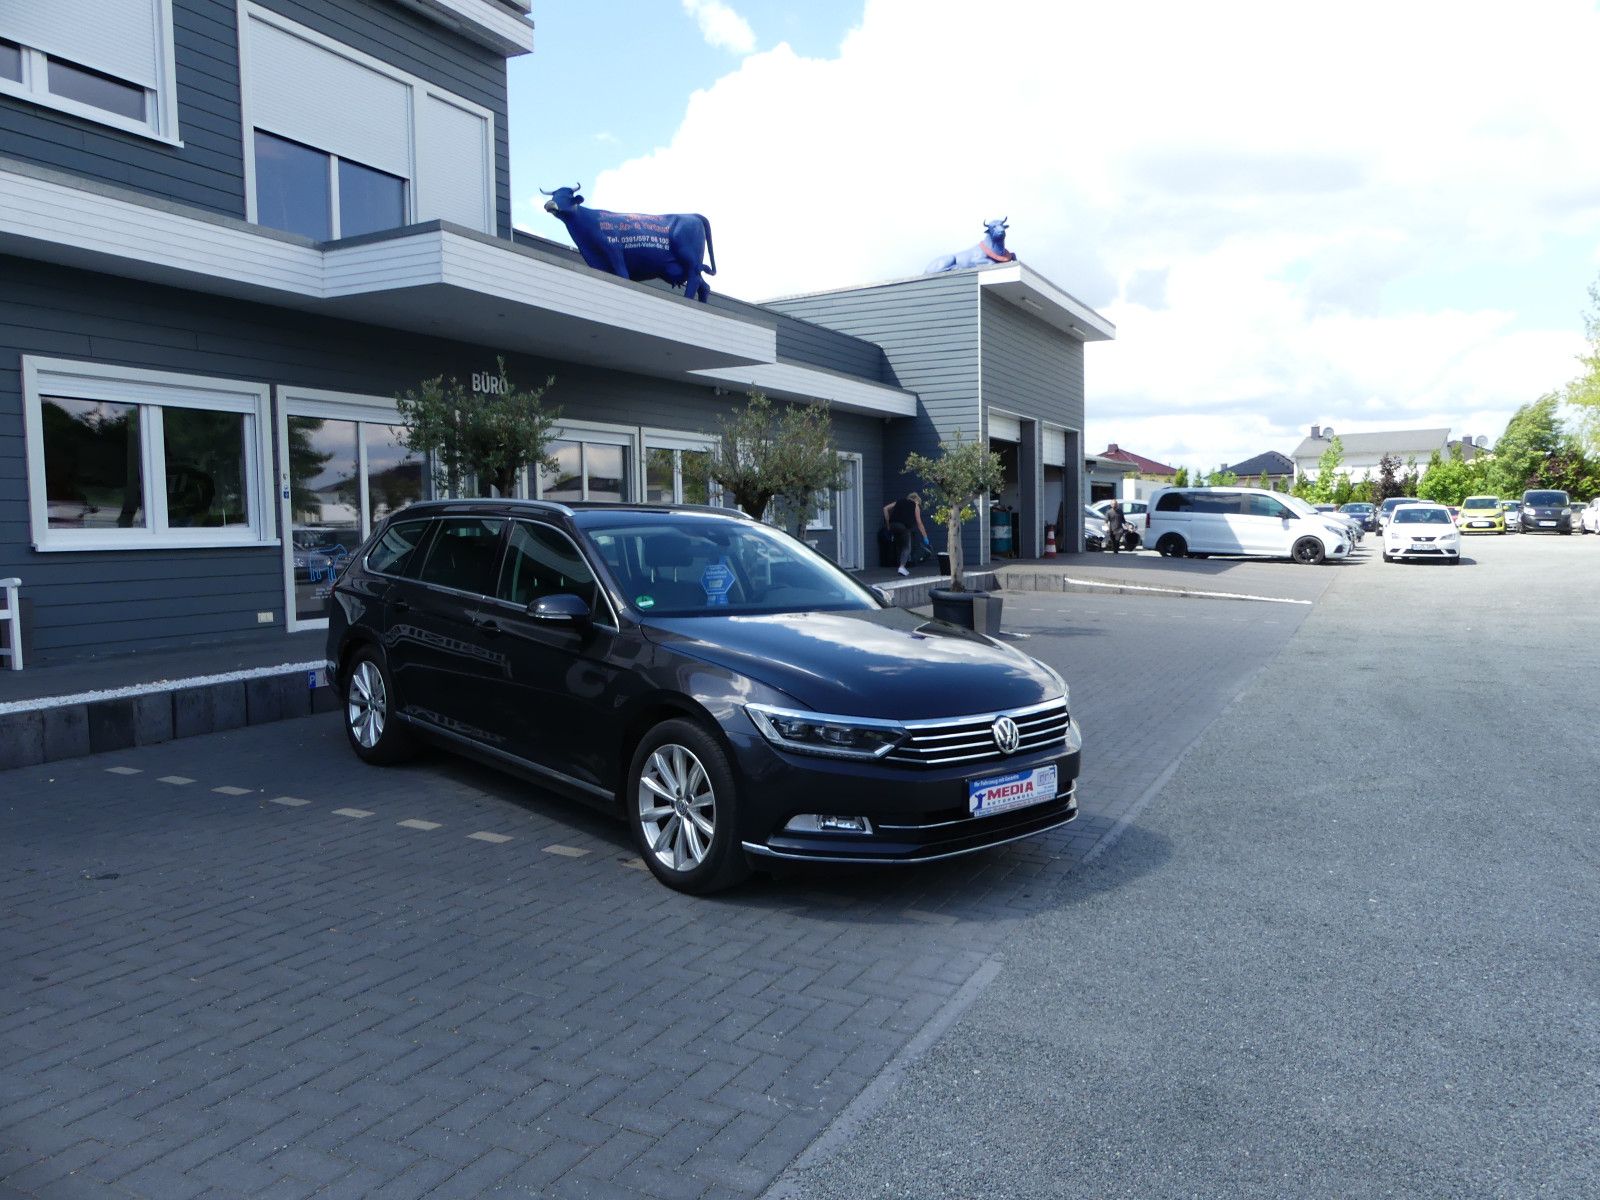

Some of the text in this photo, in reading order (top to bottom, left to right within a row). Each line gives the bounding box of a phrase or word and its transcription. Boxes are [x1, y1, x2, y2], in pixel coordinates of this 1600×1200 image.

[472, 371, 508, 395] BÜRO
[987, 781, 1034, 800] MEDIA
[987, 793, 1034, 806] AUTOHANDEL
